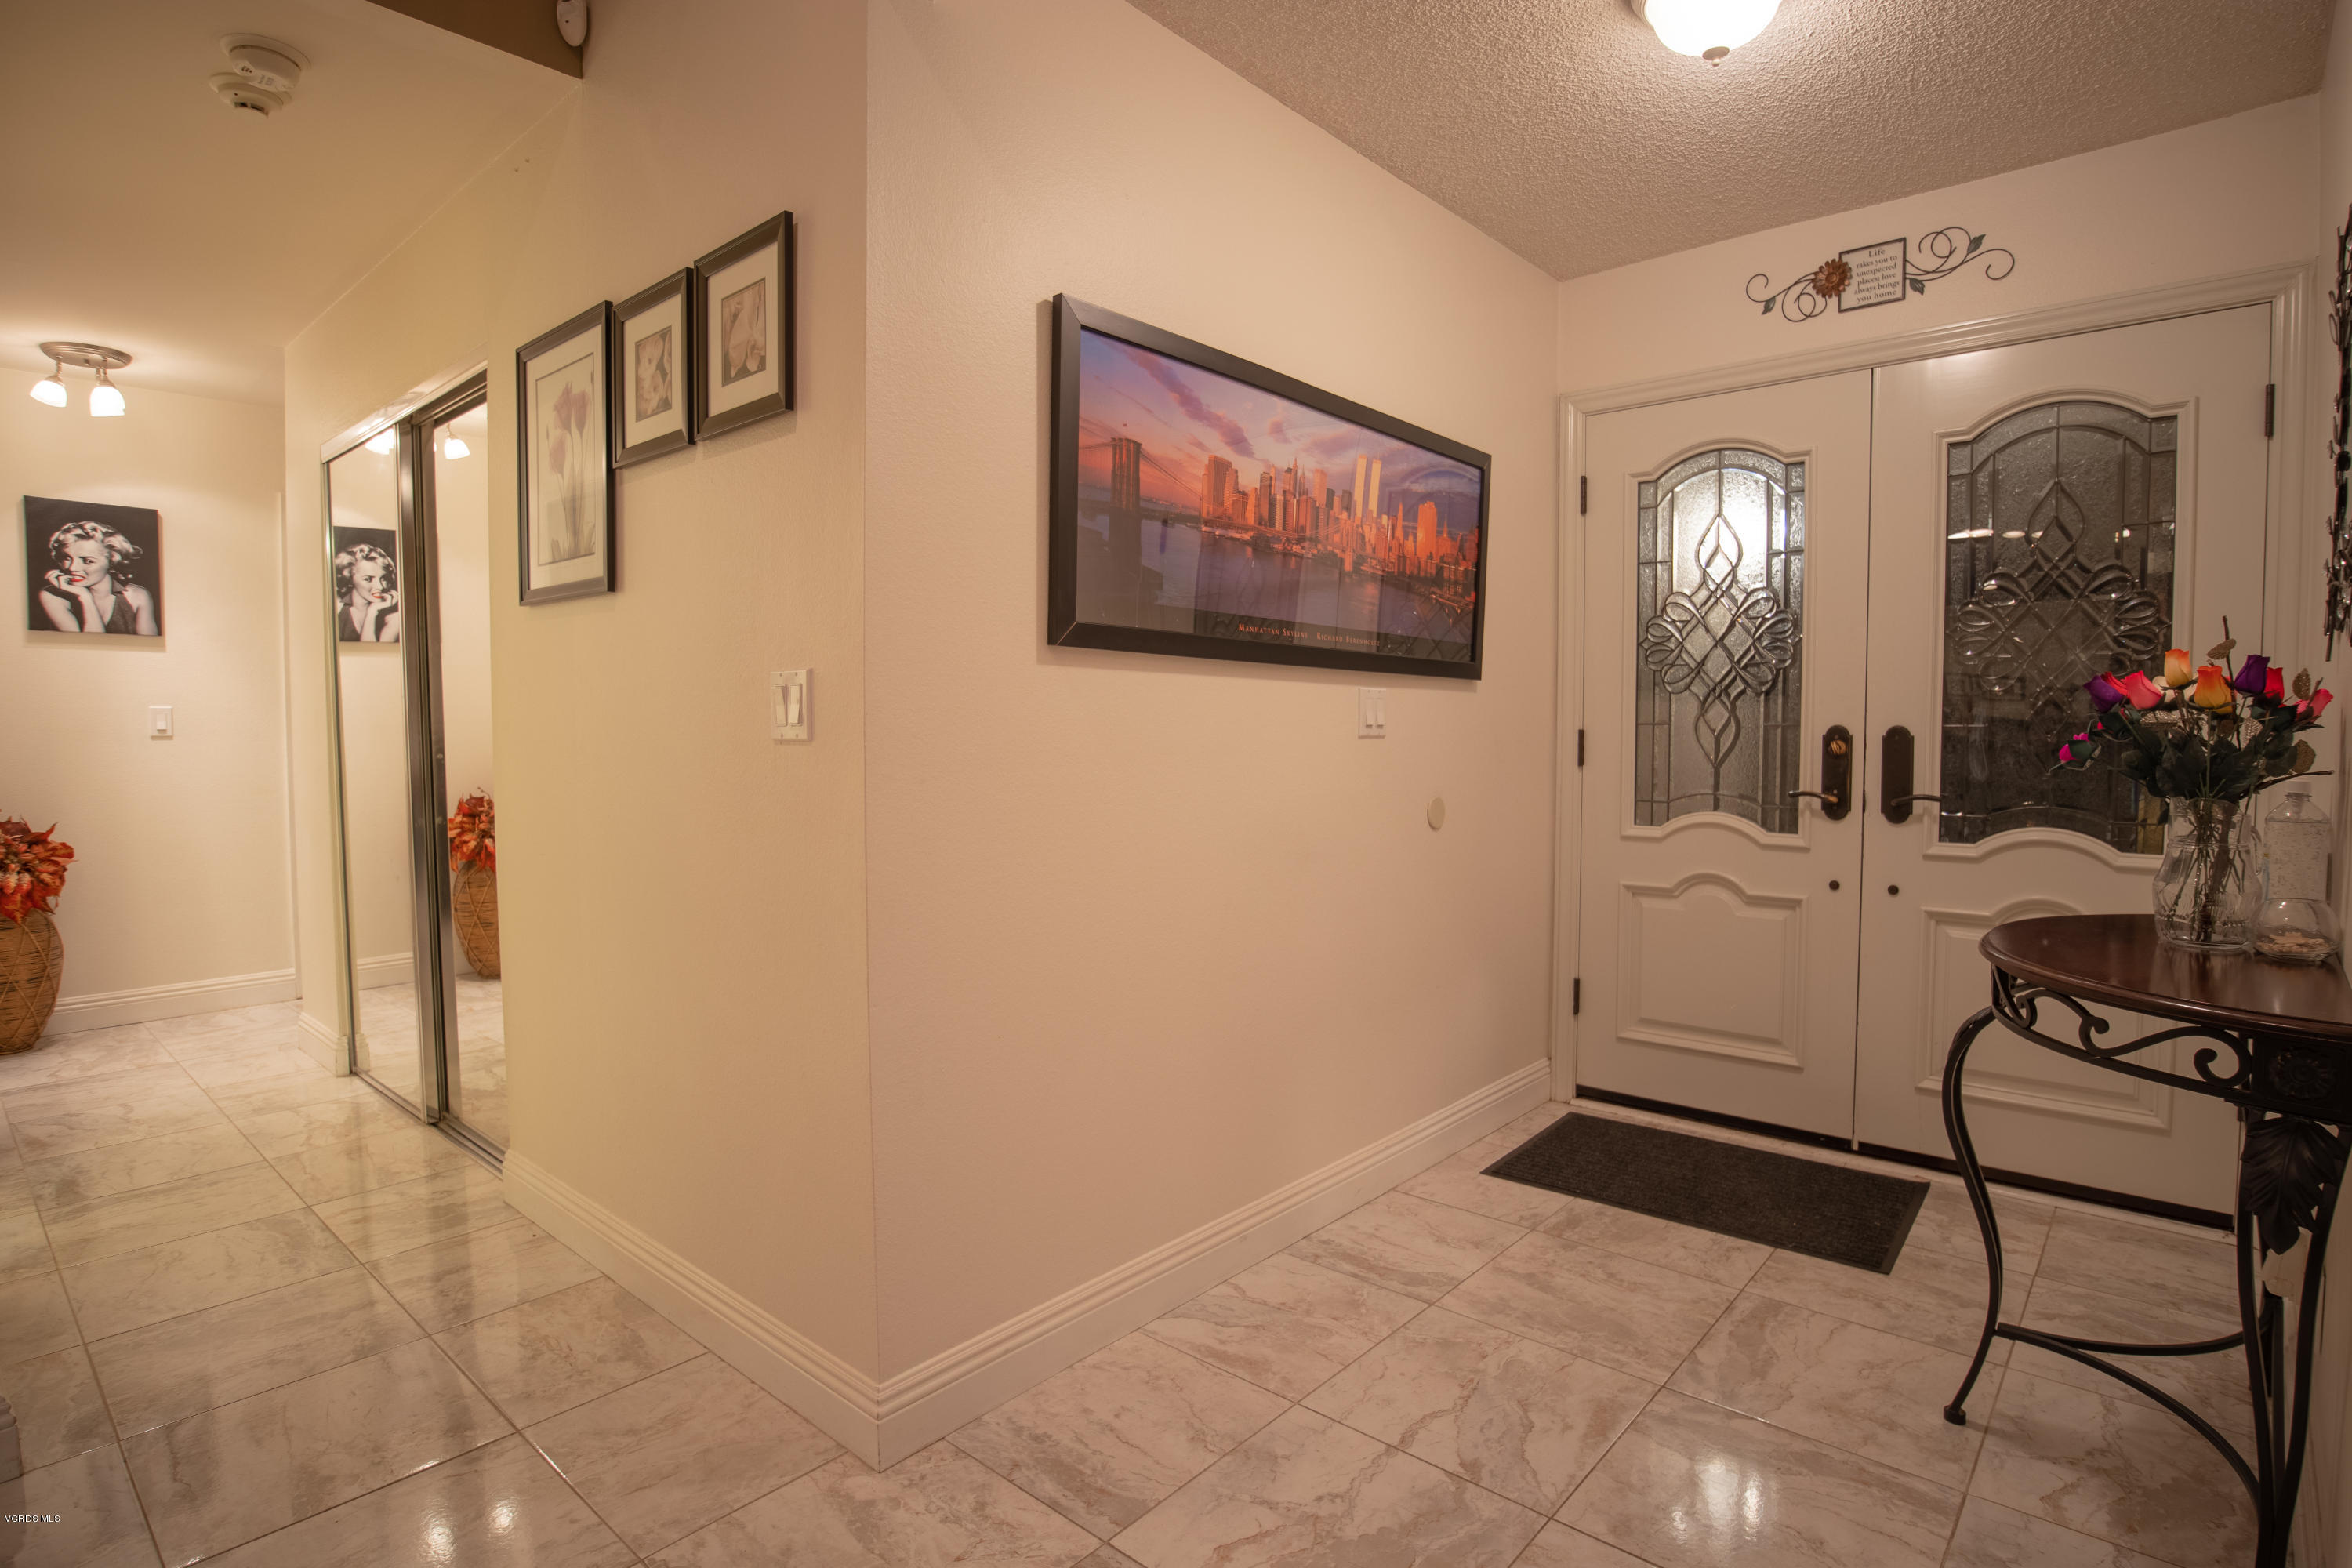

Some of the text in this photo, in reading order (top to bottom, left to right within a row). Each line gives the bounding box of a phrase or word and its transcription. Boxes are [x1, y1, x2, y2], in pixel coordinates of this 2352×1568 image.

[1869, 248, 1886, 258] Life
[1857, 260, 1874, 269] takes
[1875, 258, 1888, 267] you
[1857, 263, 1897, 277] unexpected
[1854, 281, 1900, 295] always brings
[1857, 290, 1896, 304] you home
